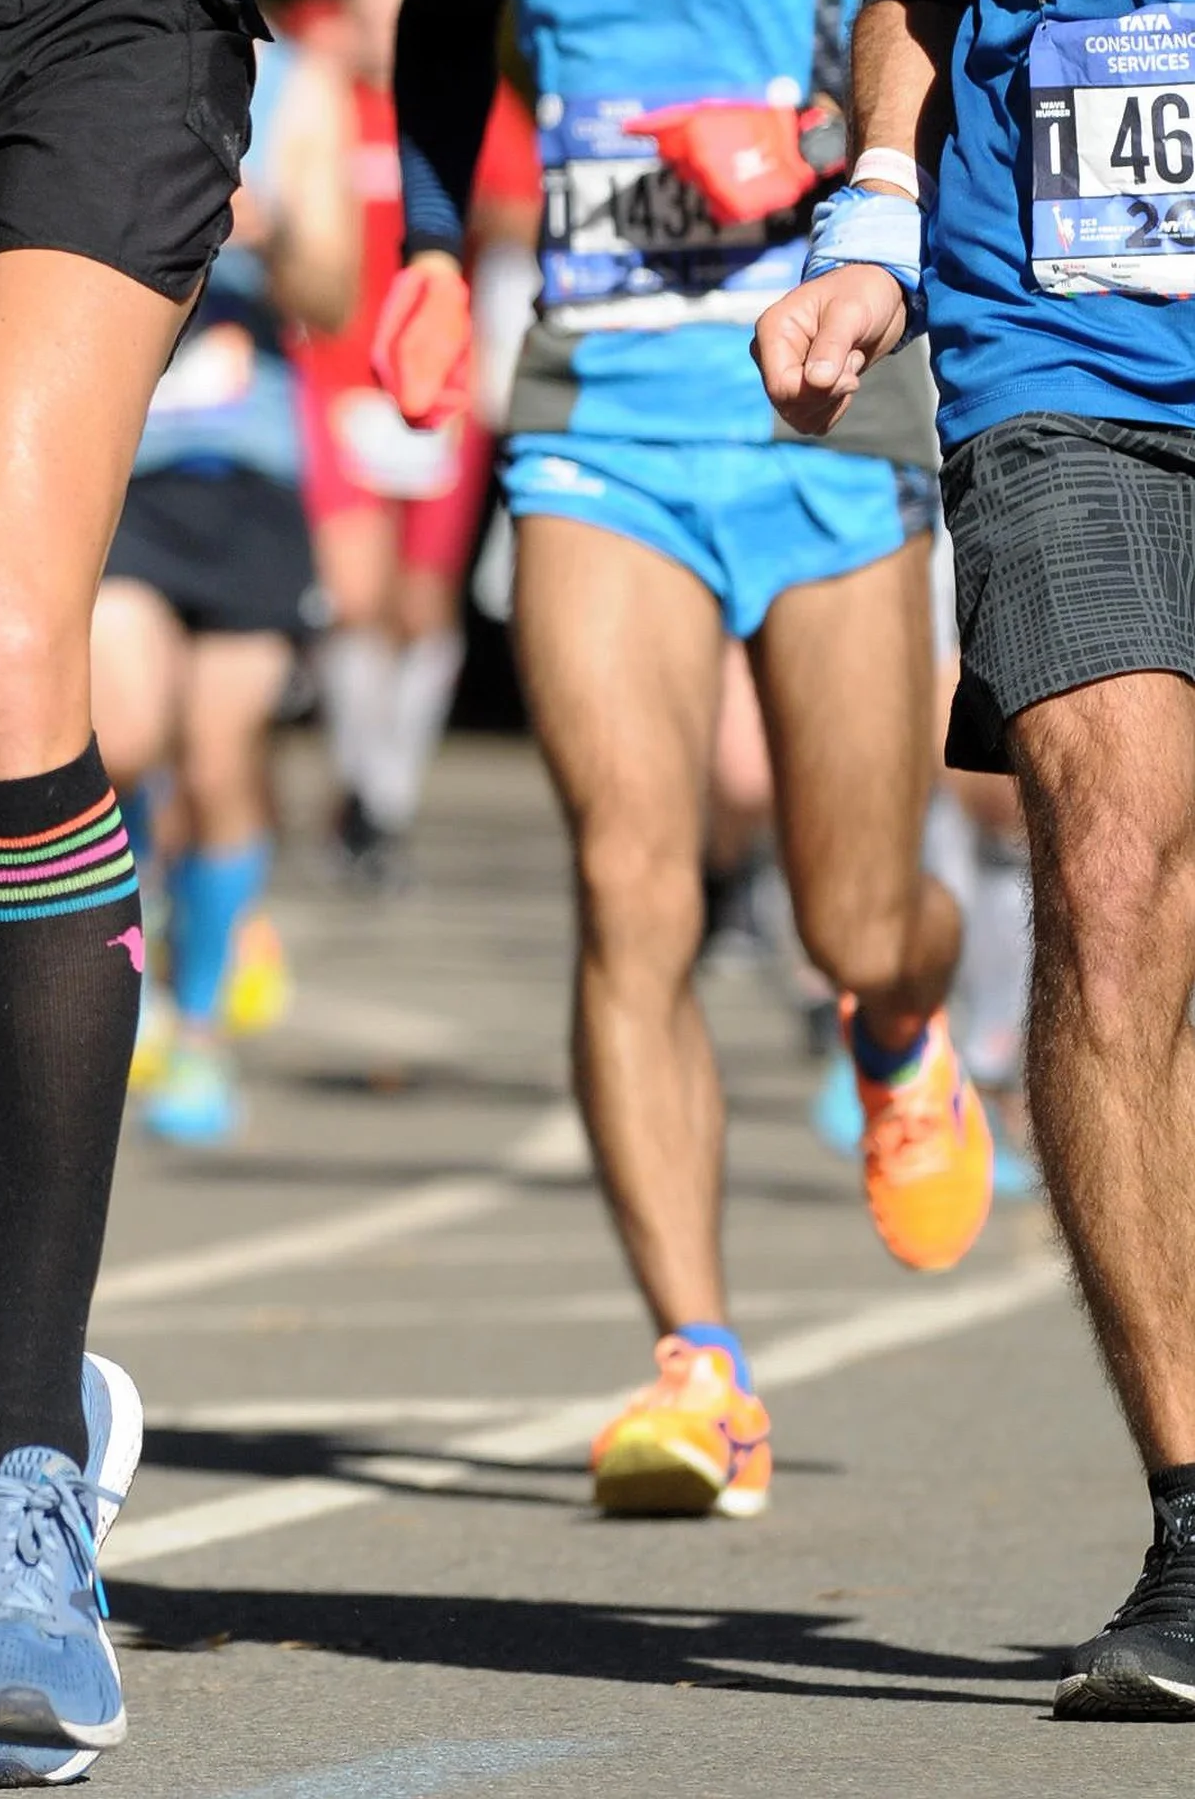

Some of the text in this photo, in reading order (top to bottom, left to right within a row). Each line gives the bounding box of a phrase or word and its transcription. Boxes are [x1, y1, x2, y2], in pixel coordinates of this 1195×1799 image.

[1117, 13, 1172, 32] TATA
[1107, 52, 1190, 74] SERVICES
[1110, 92, 1195, 186] 46
